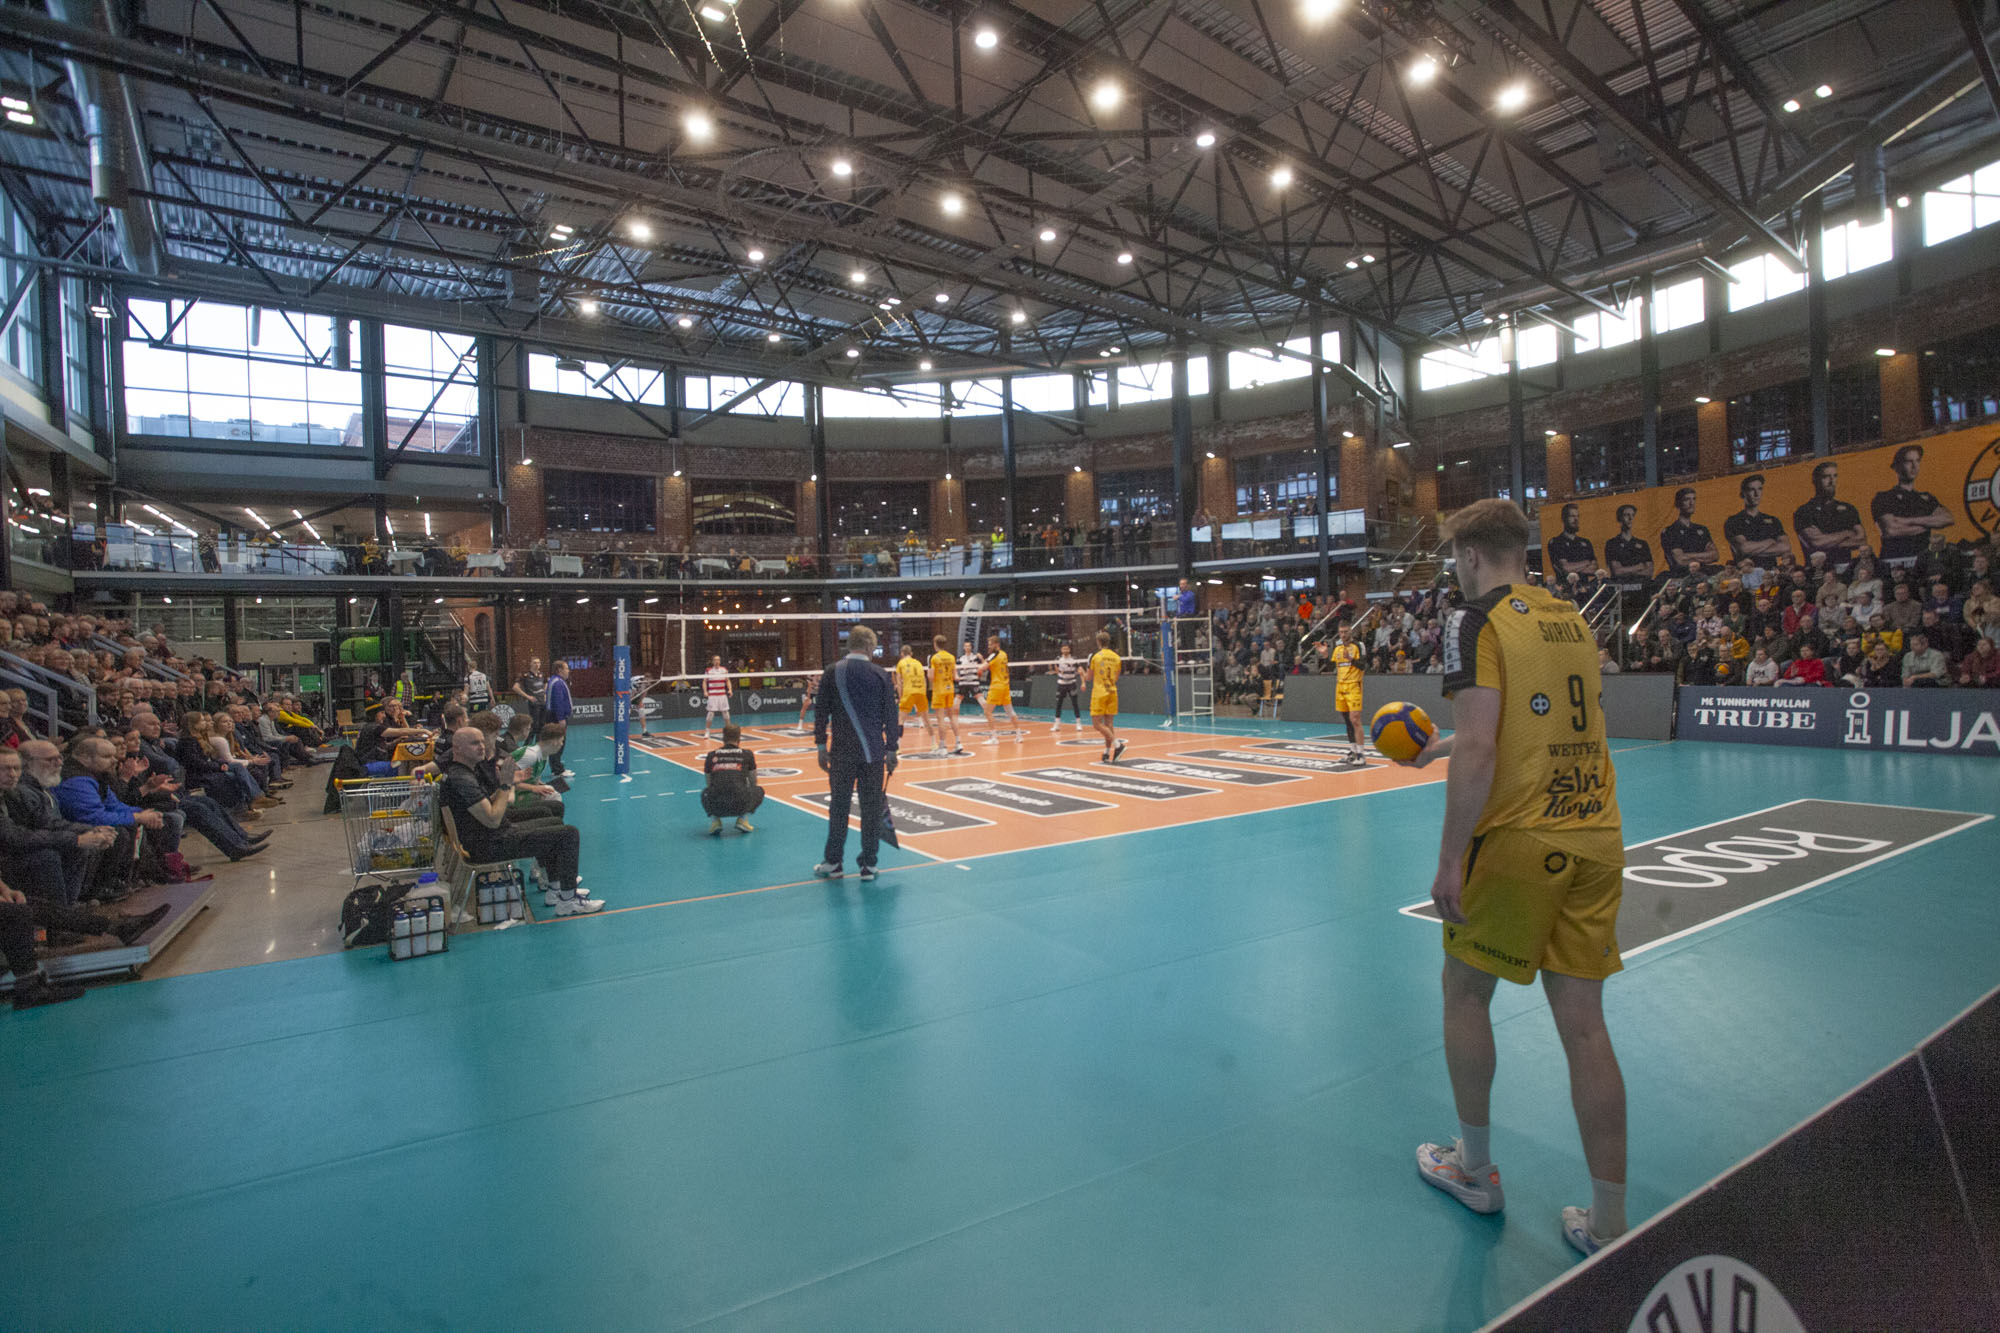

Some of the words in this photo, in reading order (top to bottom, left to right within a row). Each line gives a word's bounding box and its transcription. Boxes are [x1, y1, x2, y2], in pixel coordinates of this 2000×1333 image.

[1568, 674, 1586, 732] 9
[1701, 697, 1714, 706] ME
[1717, 697, 1768, 708] TUNNEMME
[1771, 698, 1810, 708] PULLAN
[1694, 708, 1816, 730] TRUBE
[1622, 827, 1893, 888] Ropo
[1472, 942, 1531, 969] RAMIRENT
